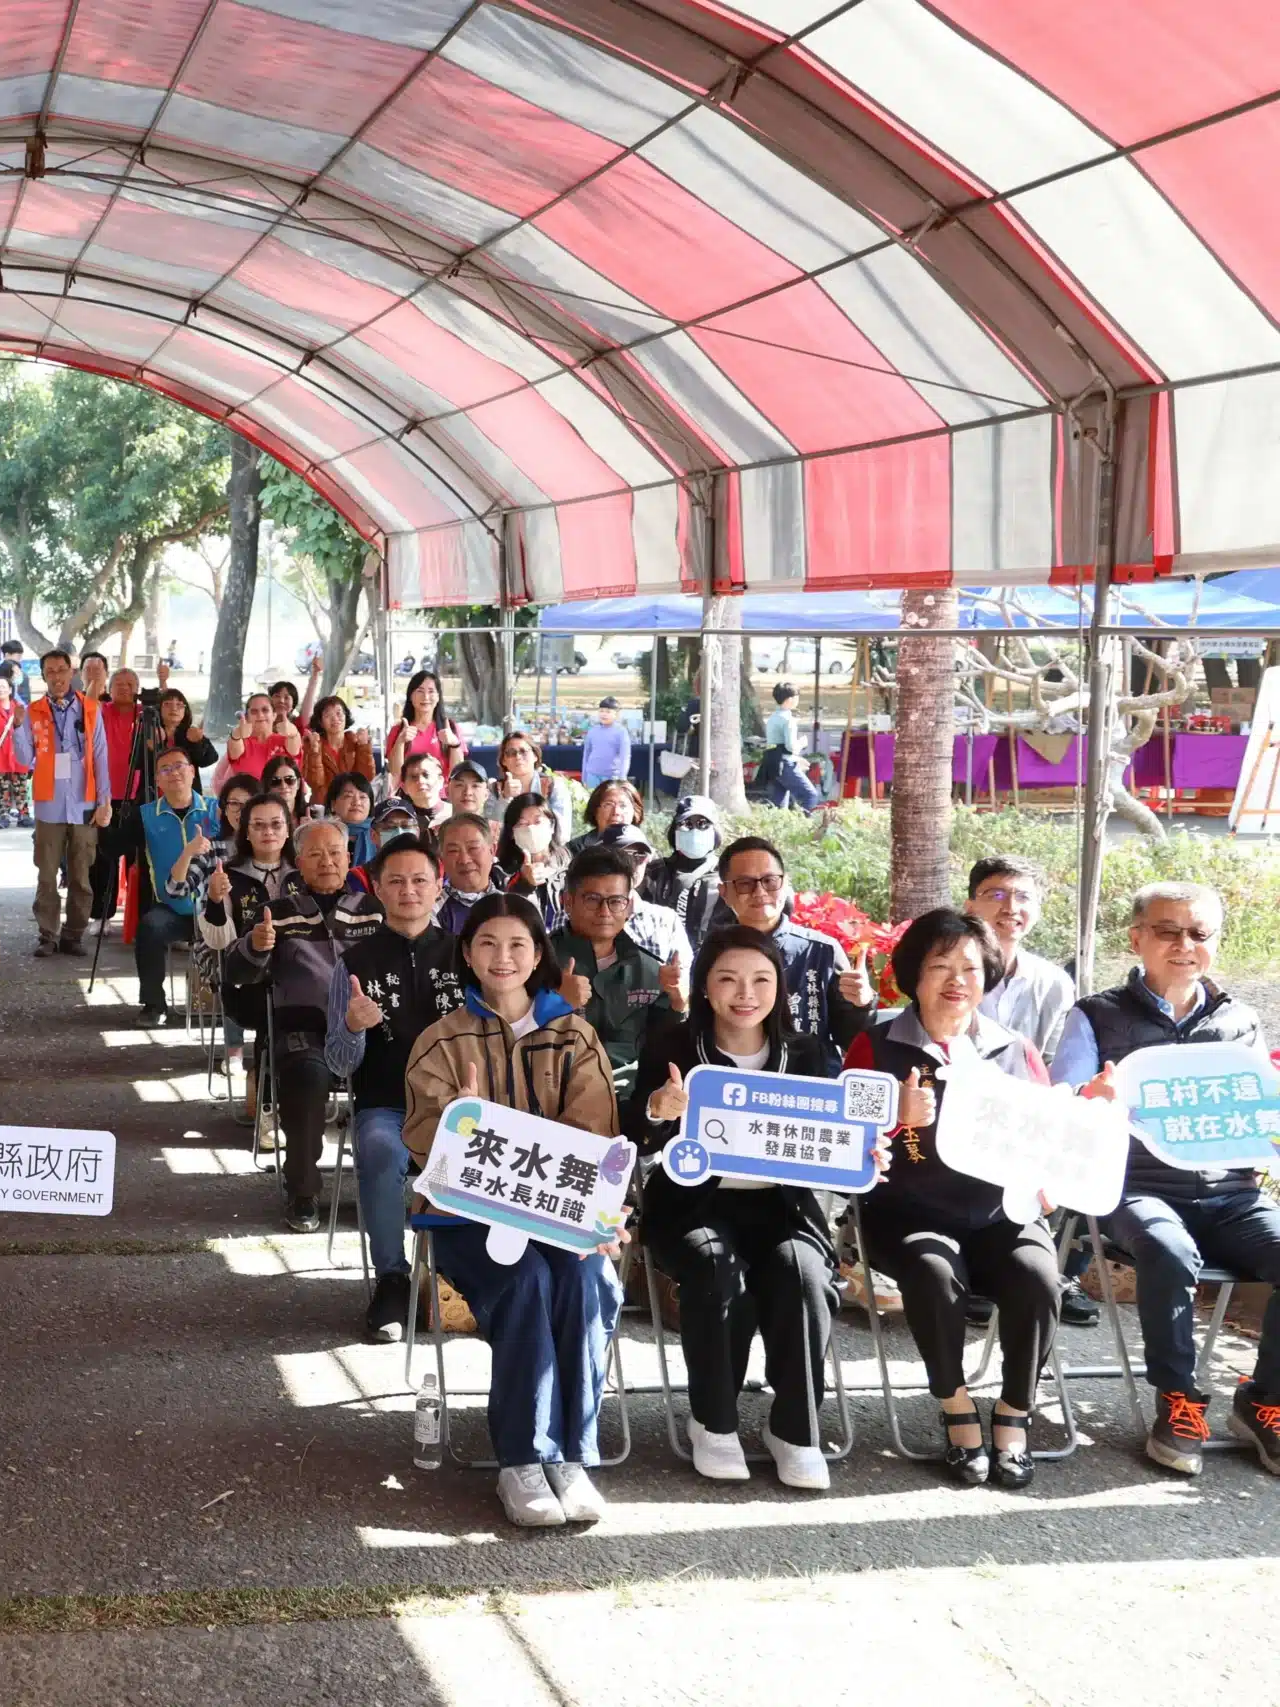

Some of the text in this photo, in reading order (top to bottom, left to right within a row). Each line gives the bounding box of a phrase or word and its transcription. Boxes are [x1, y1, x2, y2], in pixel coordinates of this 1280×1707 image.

[385, 973, 400, 1008] 秘書
[748, 1119, 852, 1146] 水舞休閒農業
[463, 1127, 599, 1197] 來水舞
[765, 1140, 832, 1163] 發展協會
[12, 1189, 104, 1205] GOVERNMENT
[459, 1166, 587, 1224] 學水長知識
